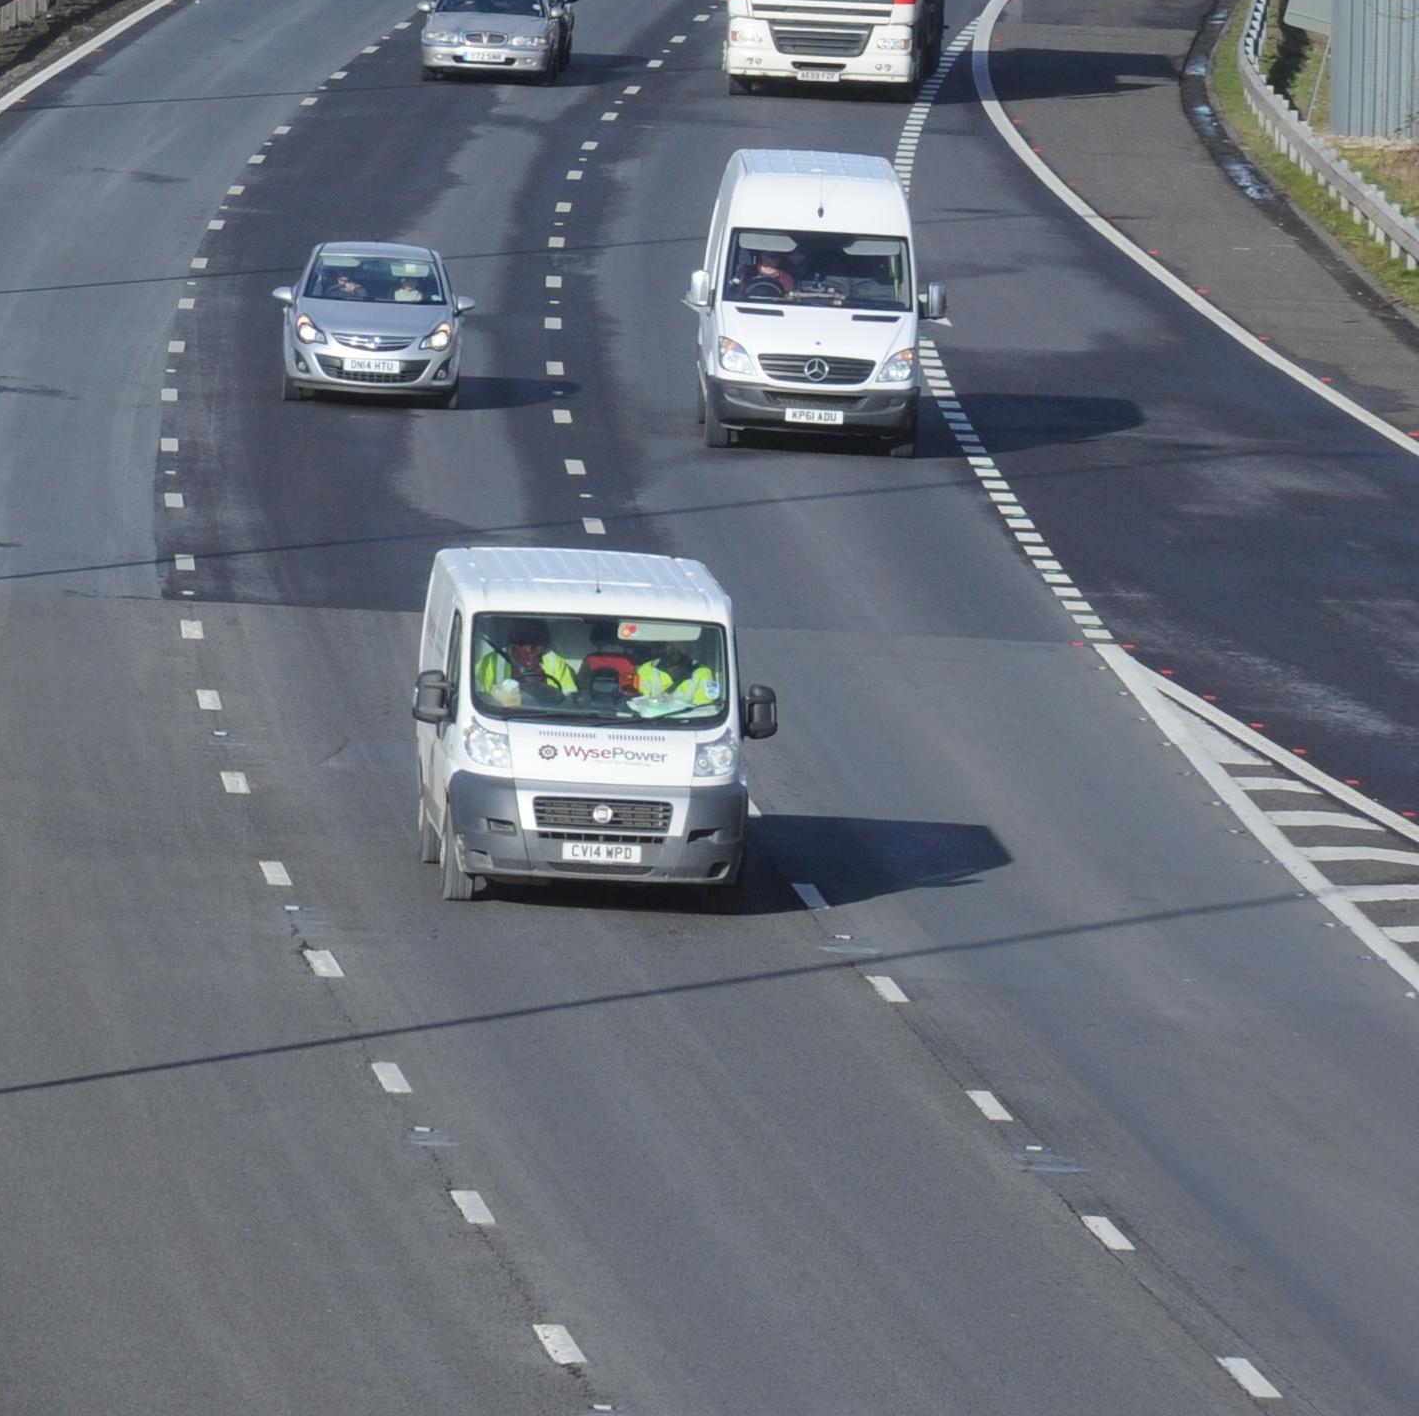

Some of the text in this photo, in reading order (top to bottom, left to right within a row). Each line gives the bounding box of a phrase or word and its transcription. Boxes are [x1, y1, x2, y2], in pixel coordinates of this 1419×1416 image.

[374, 360, 394, 371] HTU
[791, 410, 837, 422] KP61 ADU
[563, 744, 669, 763] WysePower
[571, 844, 633, 860] CV14 WPD
